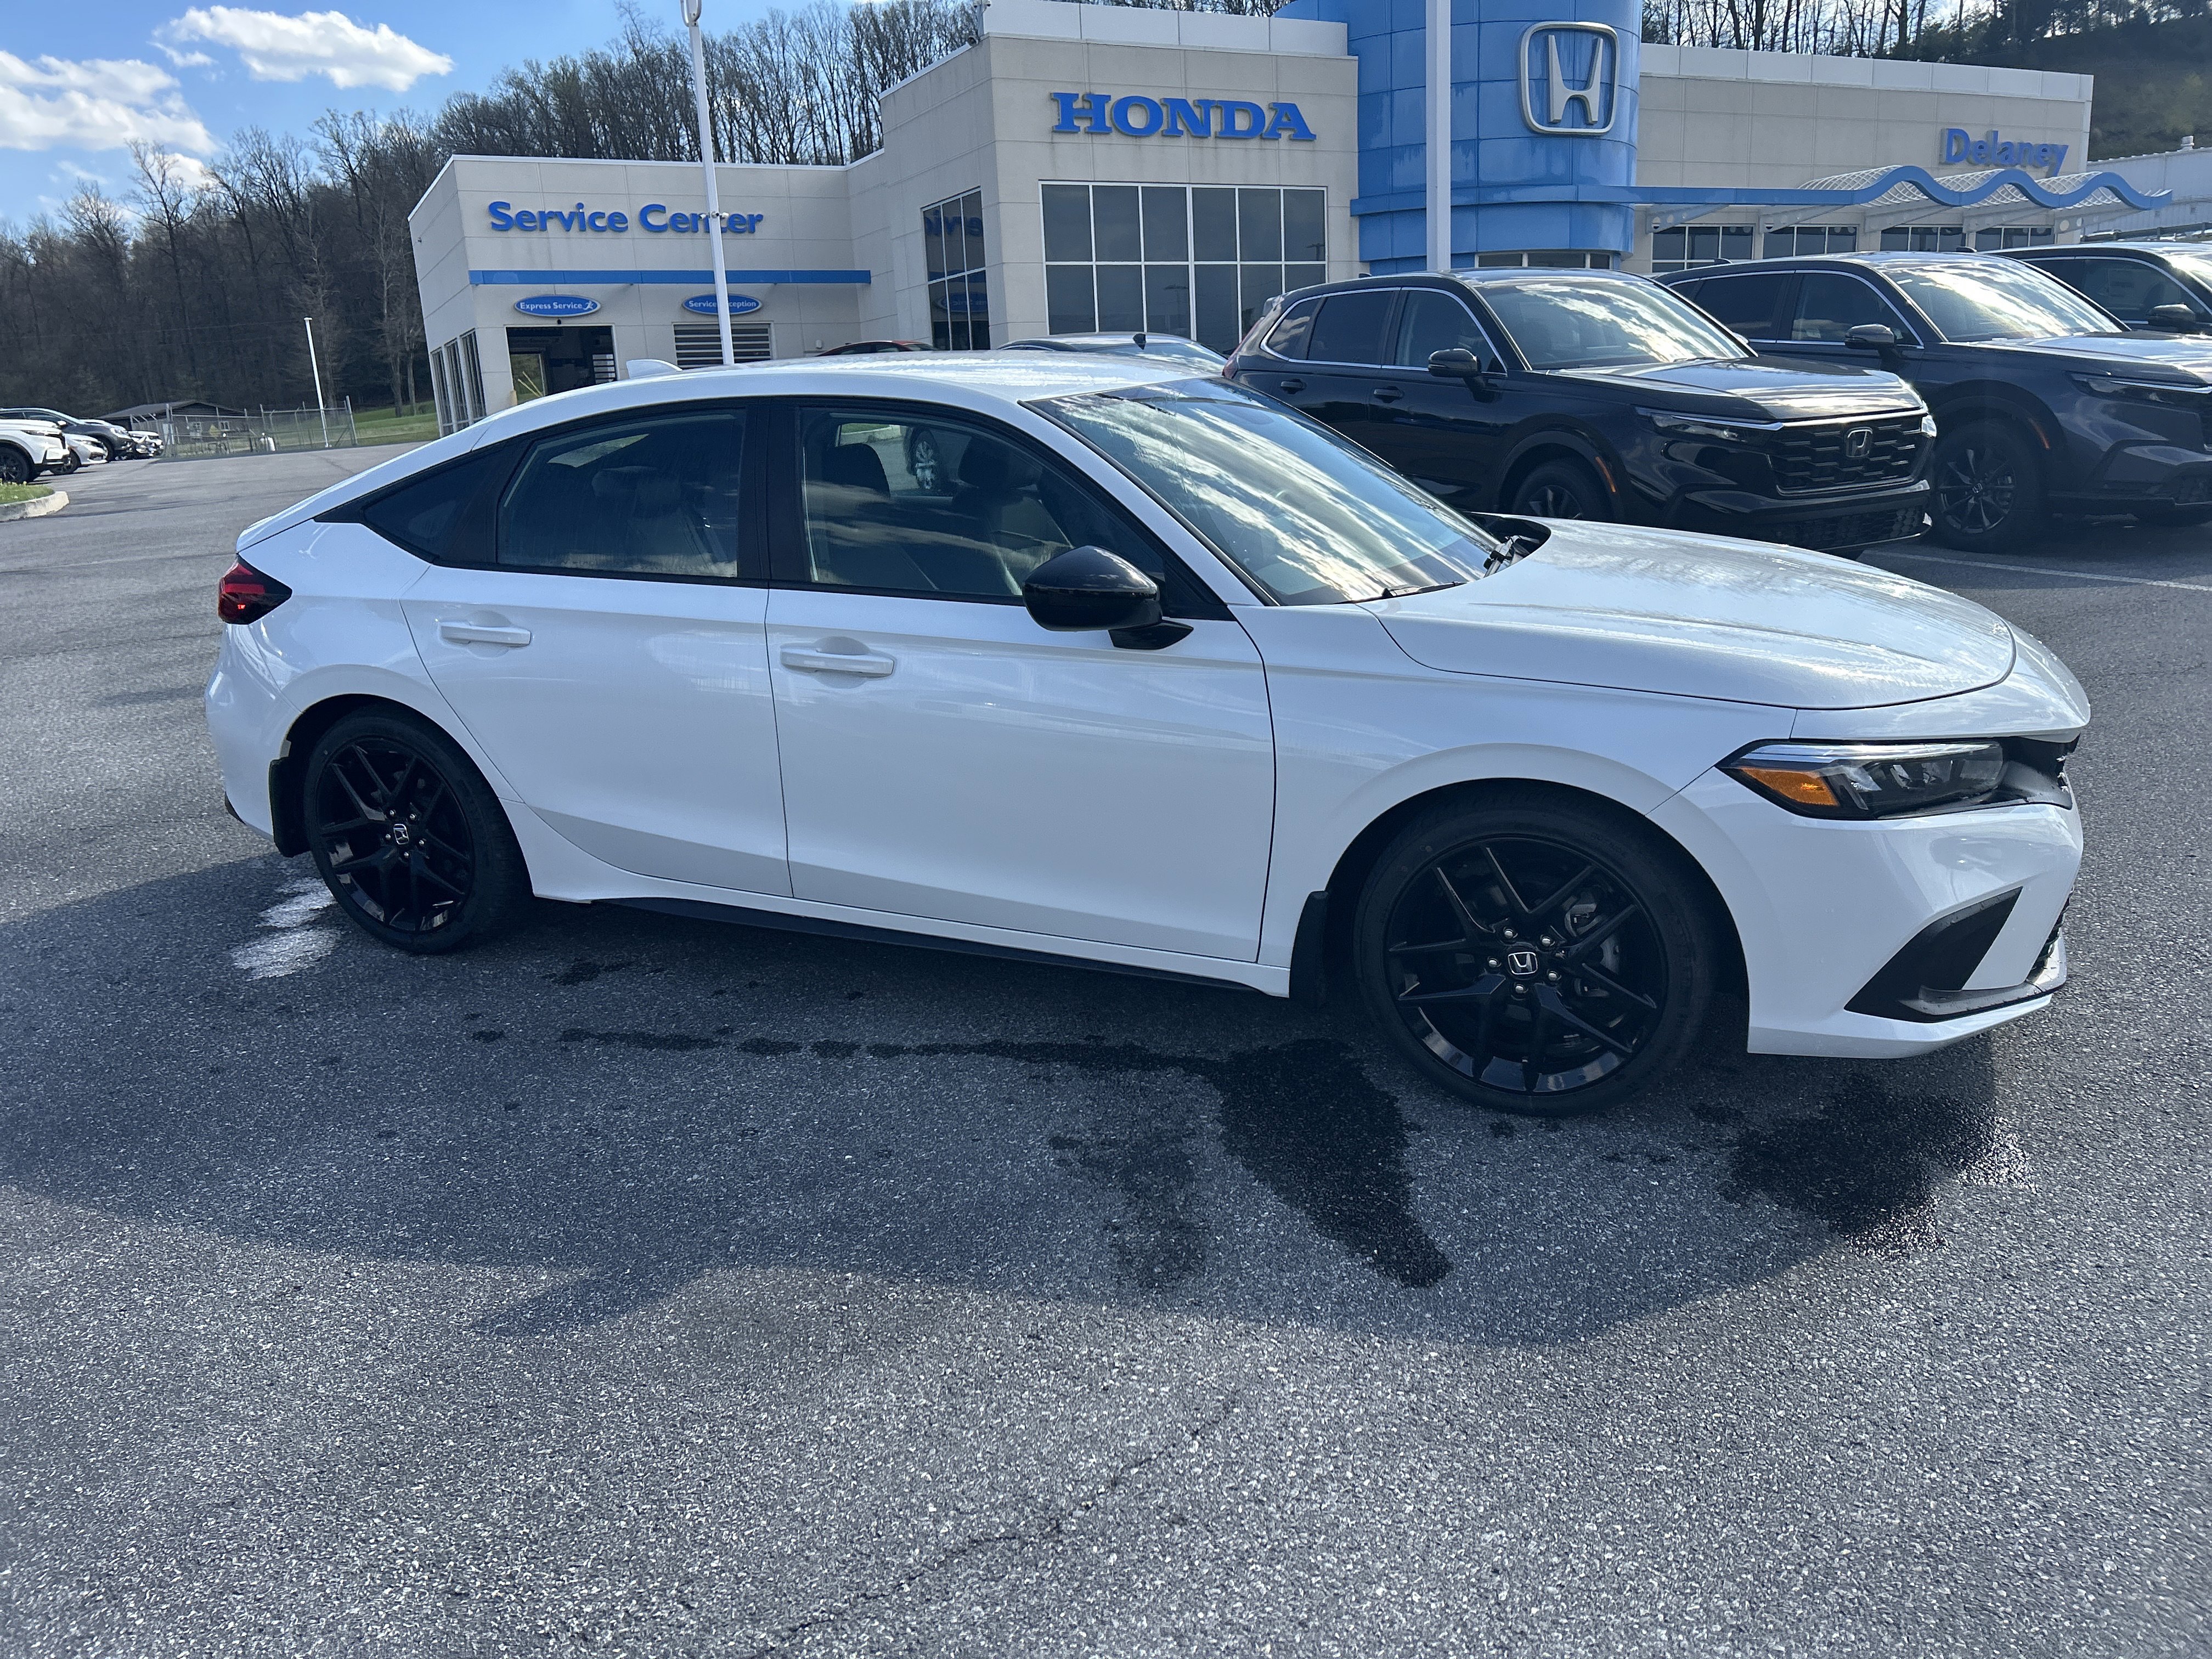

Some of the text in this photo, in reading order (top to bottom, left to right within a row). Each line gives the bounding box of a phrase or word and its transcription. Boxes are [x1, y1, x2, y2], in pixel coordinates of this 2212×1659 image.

[1050, 92, 1317, 141] HONDA
[1940, 128, 2069, 178] Delaney
[488, 201, 628, 232] Service
[520, 301, 583, 311] Express Service
